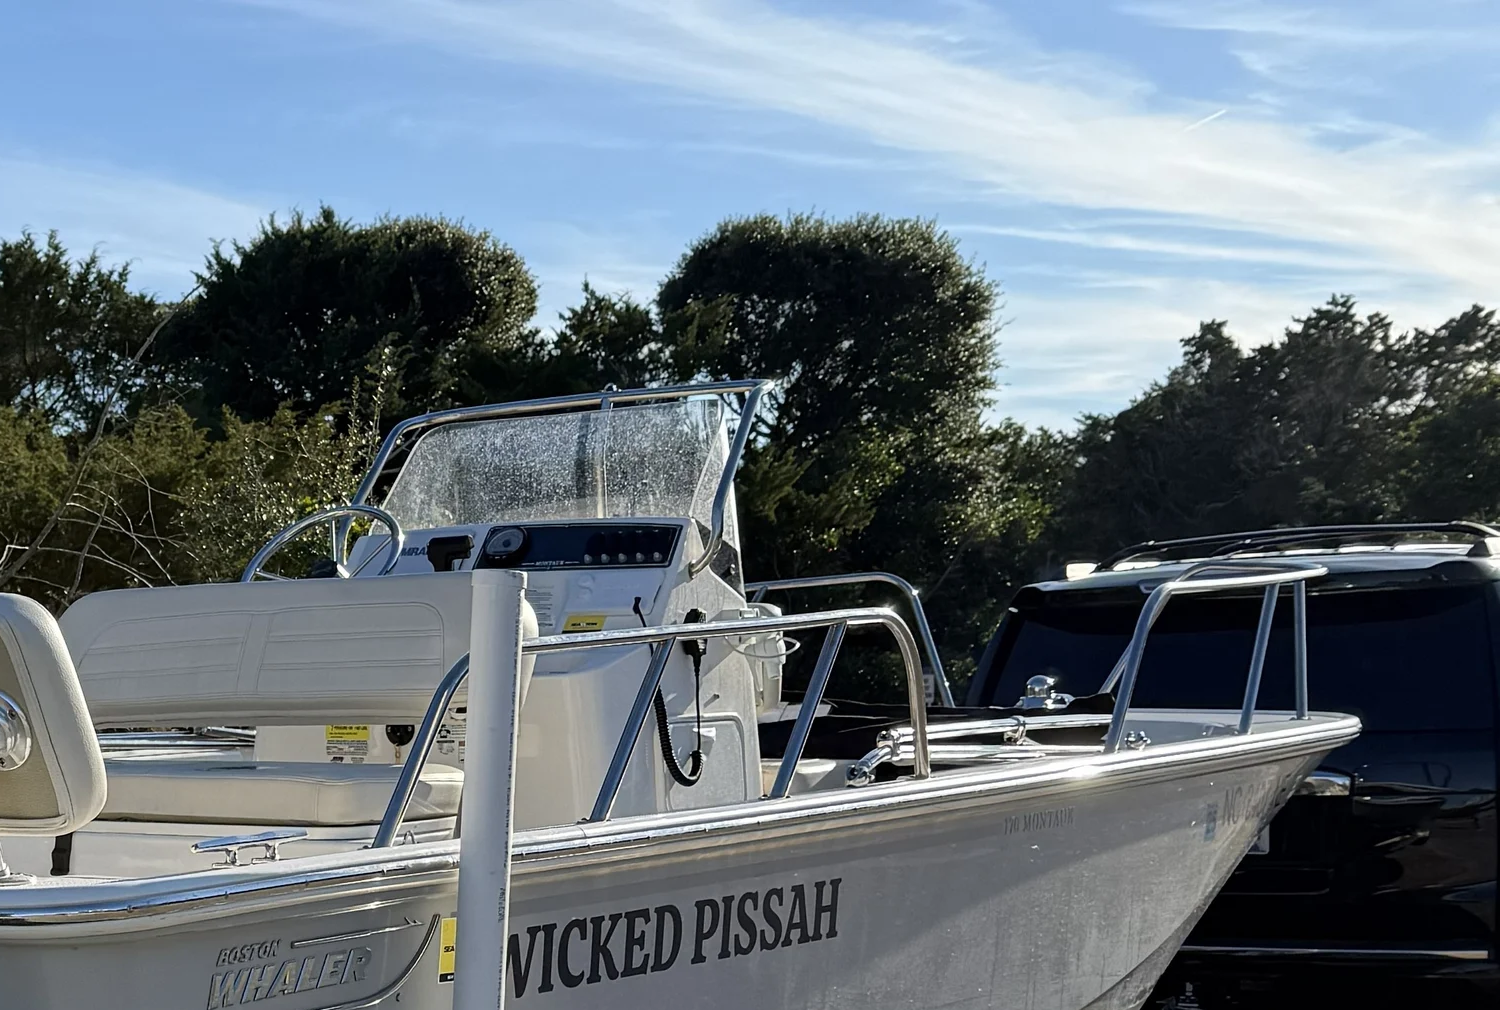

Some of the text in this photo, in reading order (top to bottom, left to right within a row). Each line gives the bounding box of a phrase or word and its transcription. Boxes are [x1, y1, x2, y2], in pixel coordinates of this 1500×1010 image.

[690, 878, 842, 965] PISSAH
[207, 947, 372, 1010] WHALER
[216, 939, 281, 968] BOSTON
